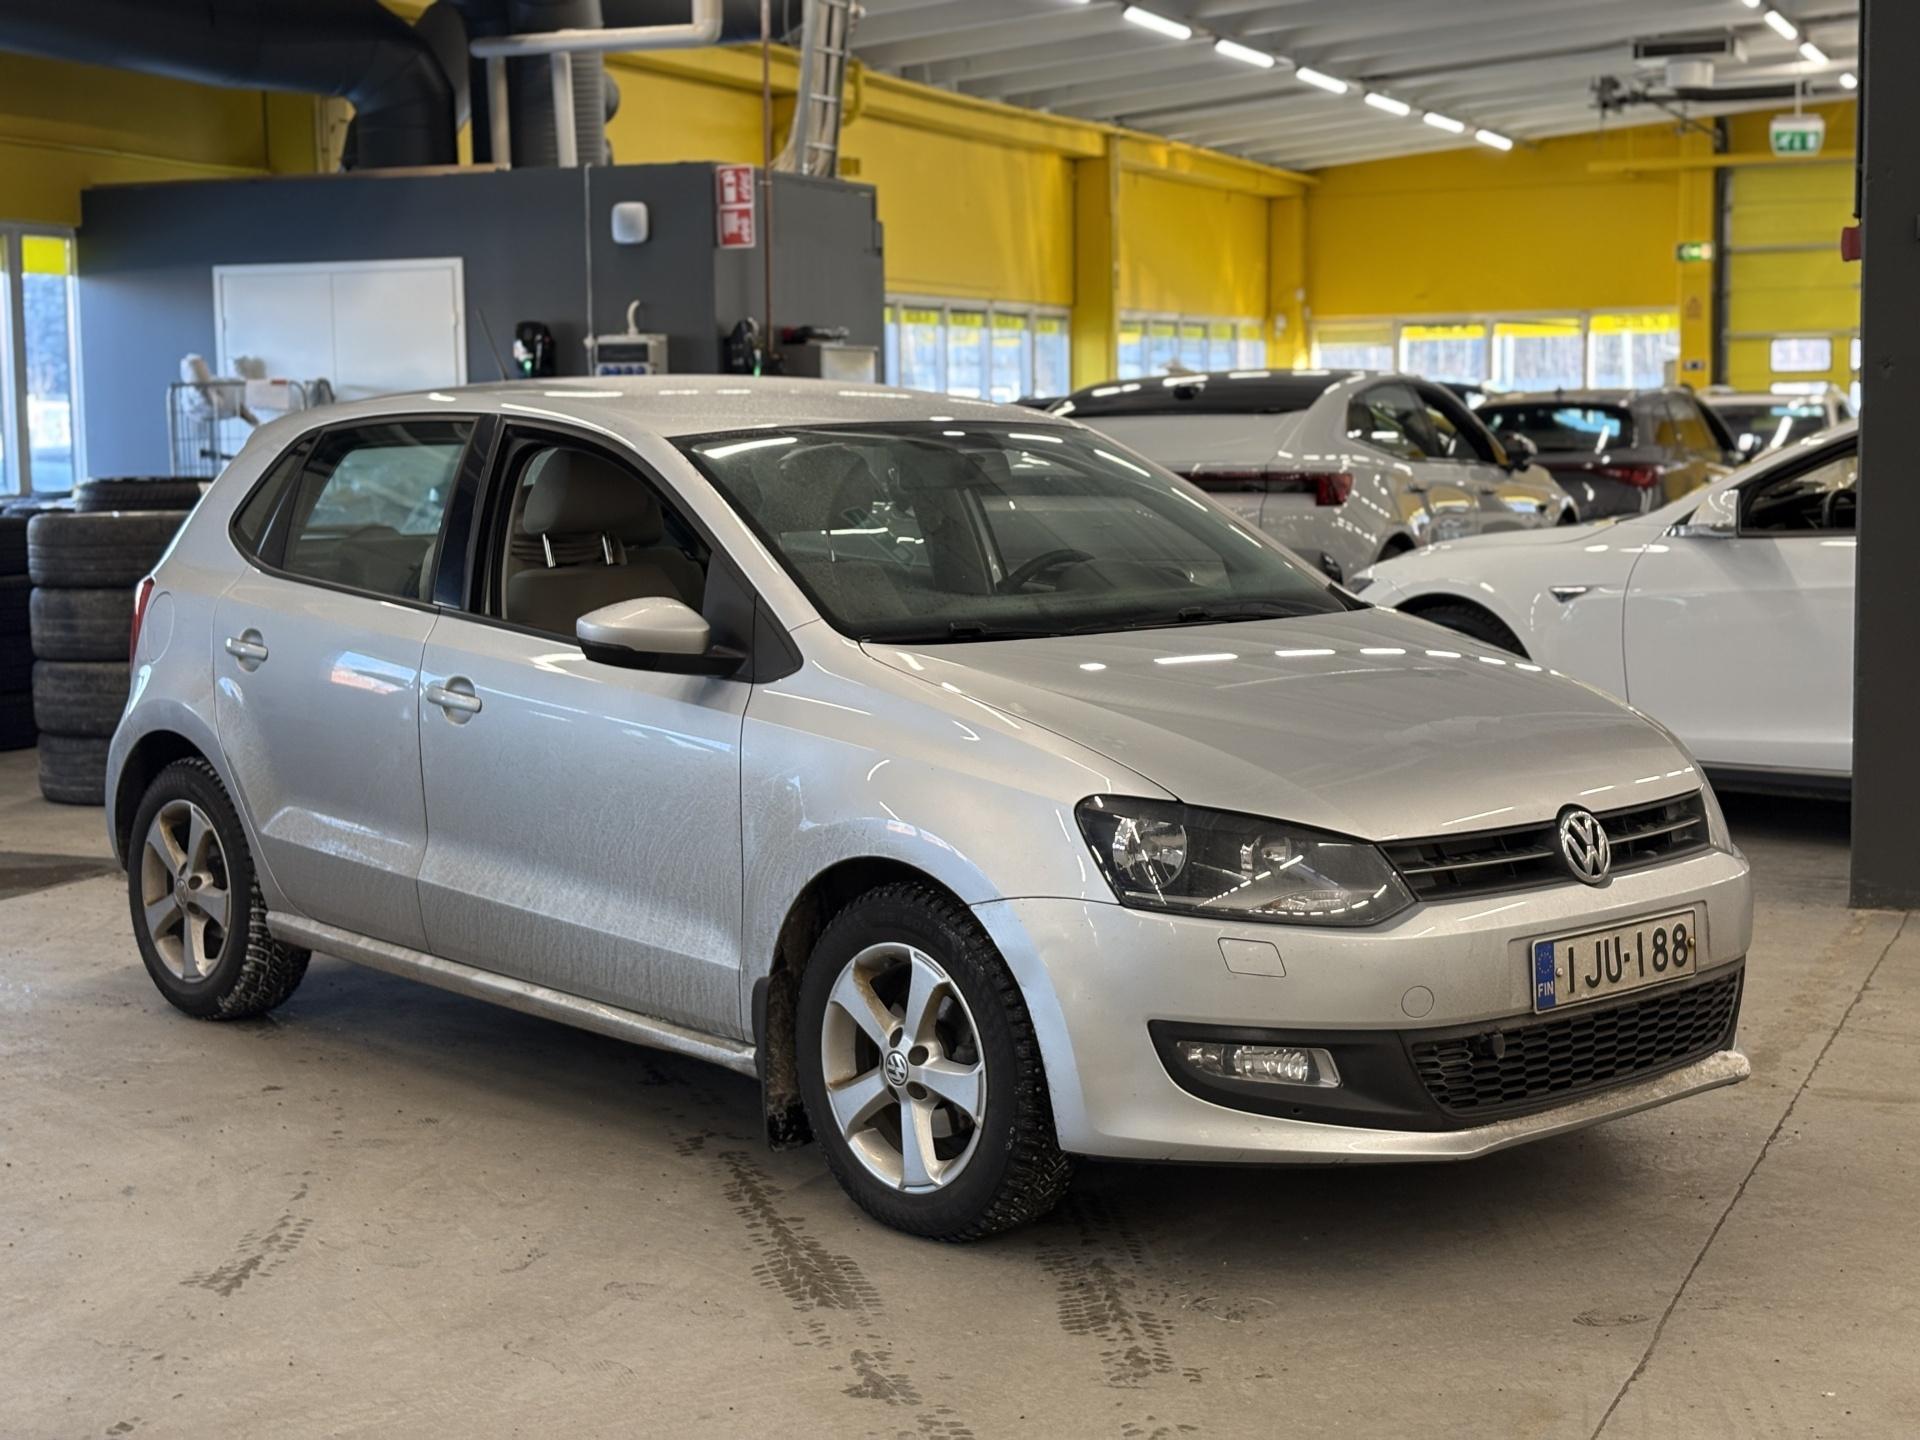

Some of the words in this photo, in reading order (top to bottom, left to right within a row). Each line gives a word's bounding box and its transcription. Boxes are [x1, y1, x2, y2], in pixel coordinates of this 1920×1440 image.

[1561, 811, 1611, 884] VW
[1537, 981, 1554, 998] FIN
[1568, 923, 1688, 993] IJU-188
